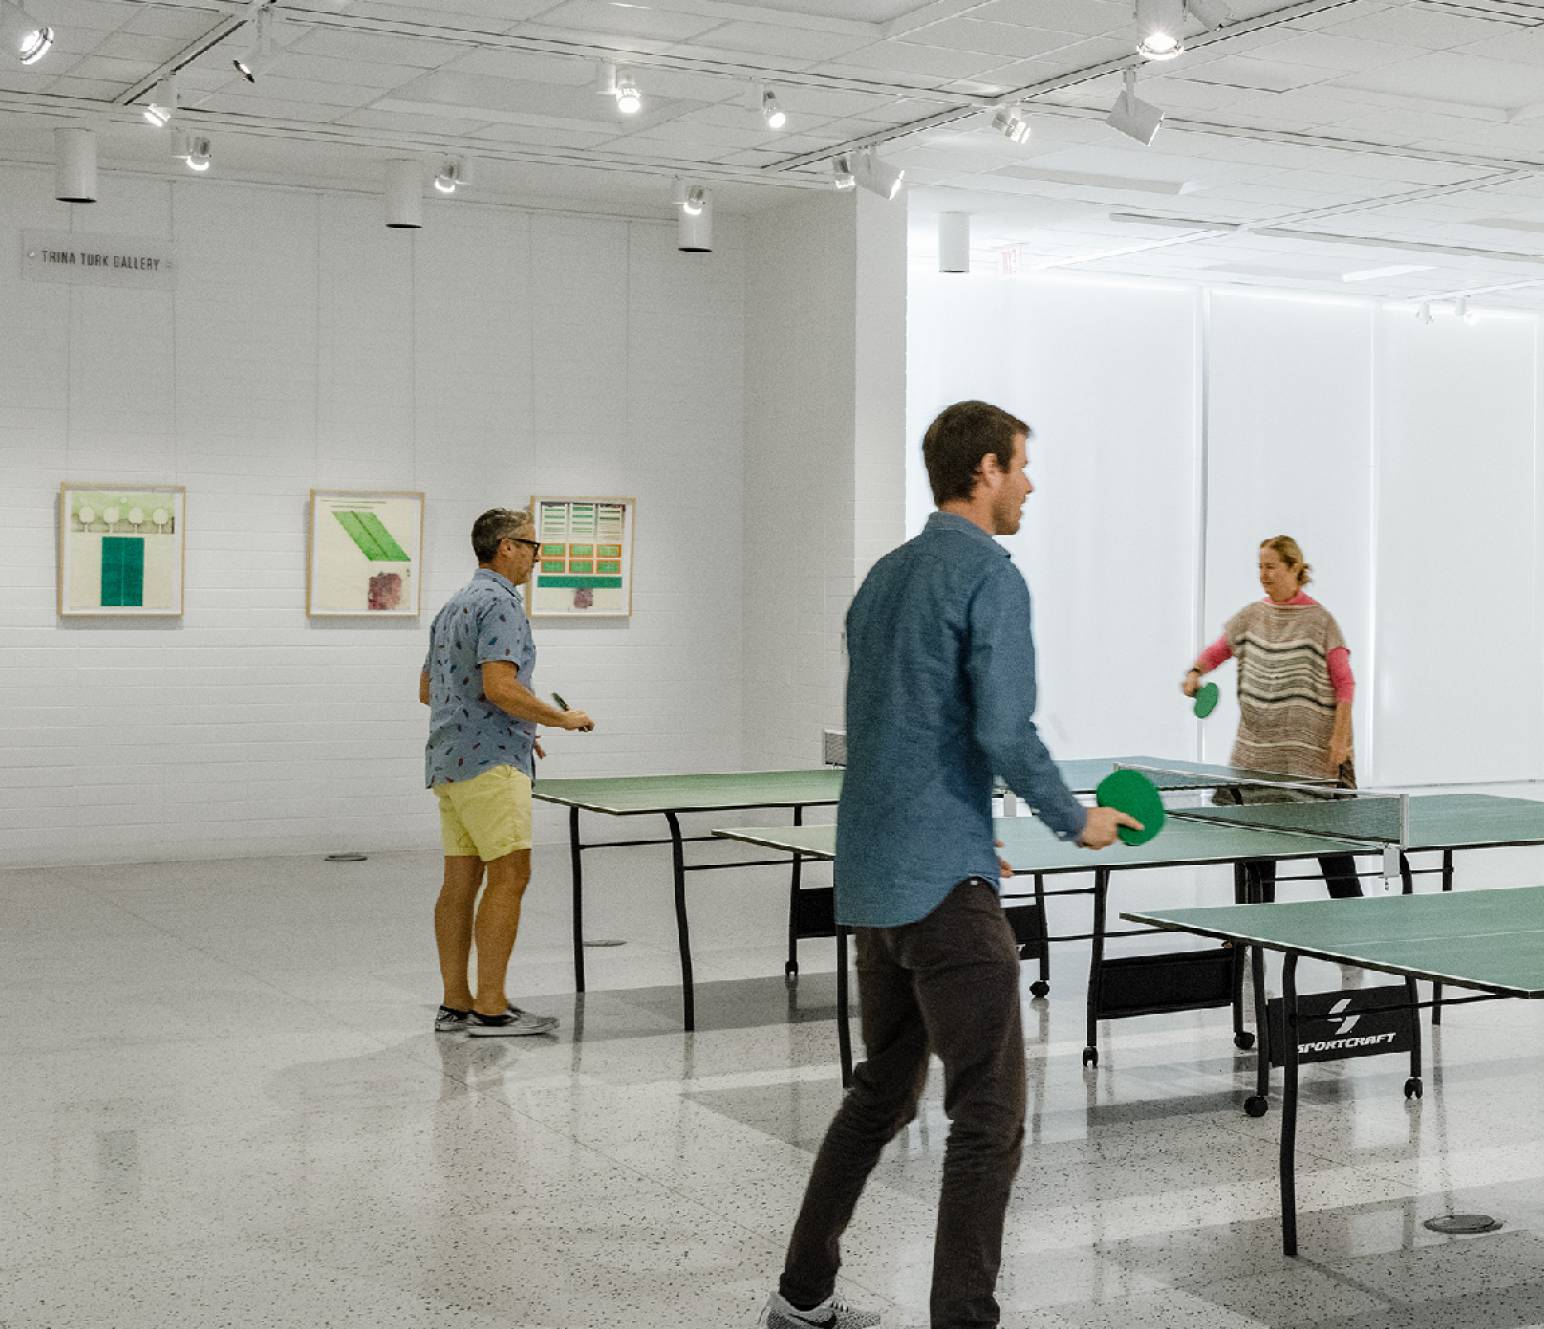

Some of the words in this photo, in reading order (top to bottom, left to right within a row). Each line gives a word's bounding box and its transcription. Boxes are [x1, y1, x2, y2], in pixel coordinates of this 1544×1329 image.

[41, 250, 76, 265] TRINA
[80, 252, 109, 267] TURK
[113, 255, 161, 271] GALLERY
[1297, 1033, 1396, 1053] SPORTCRAFT
